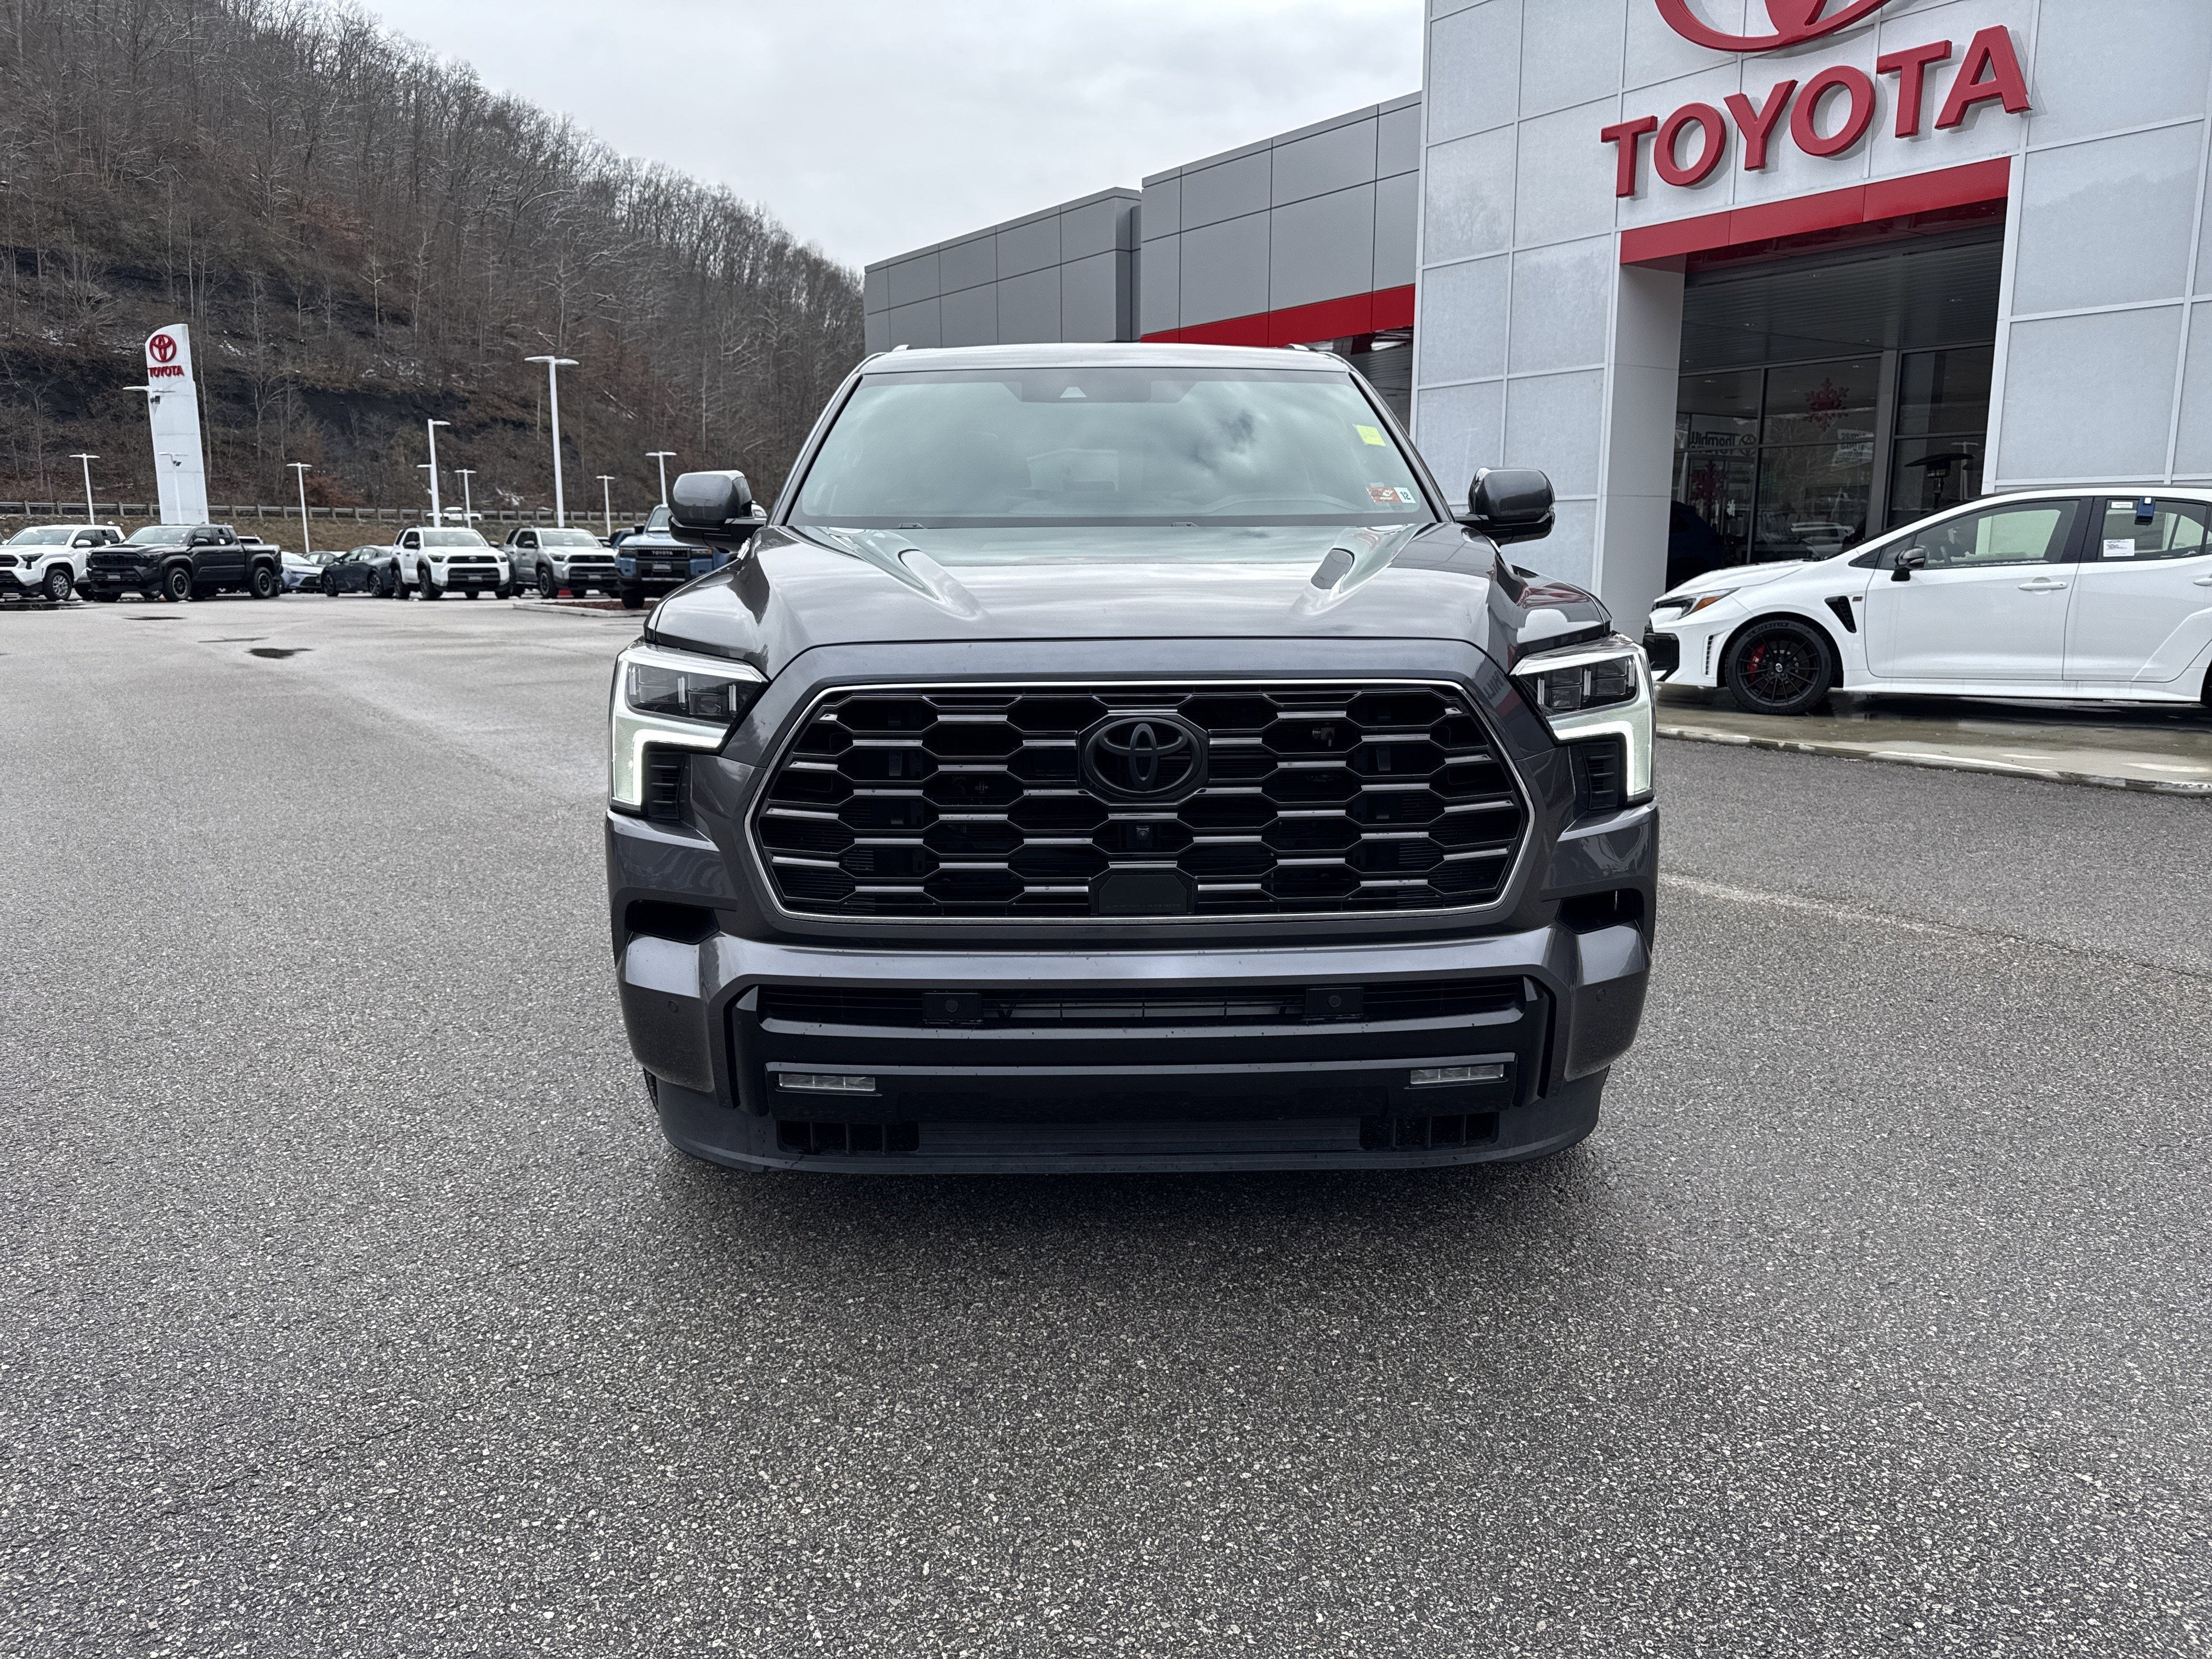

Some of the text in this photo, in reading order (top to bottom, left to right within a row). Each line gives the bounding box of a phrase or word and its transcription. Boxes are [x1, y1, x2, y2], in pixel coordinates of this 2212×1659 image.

[1601, 25, 2030, 198] TOYOTA
[148, 365, 184, 377] TOYOTA
[1400, 492, 1412, 500] 12
